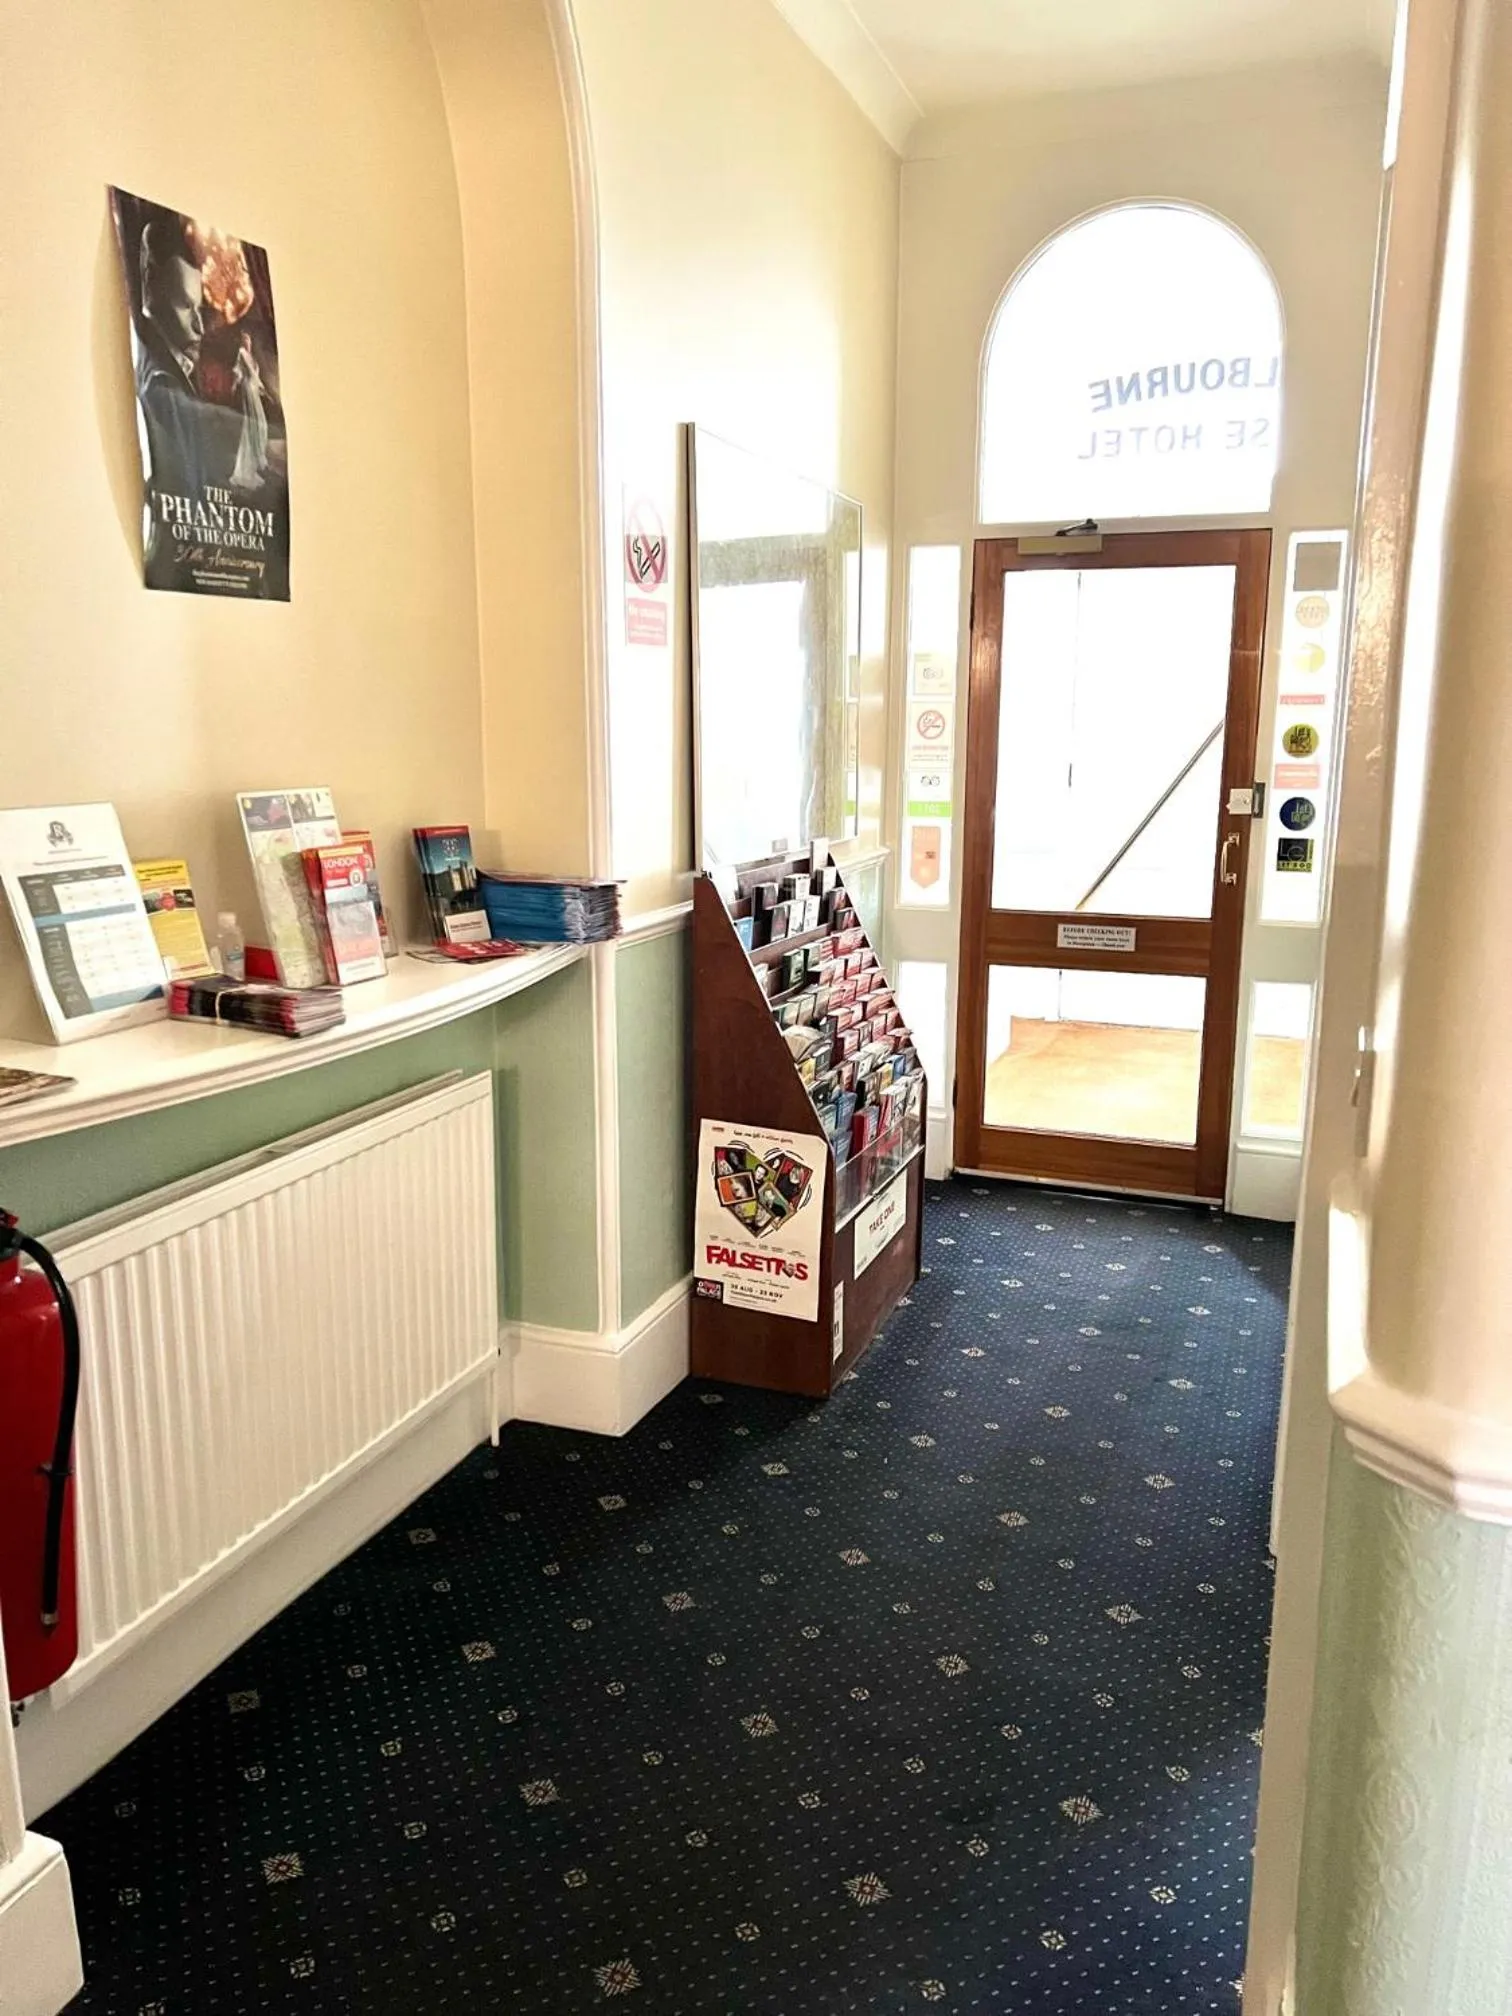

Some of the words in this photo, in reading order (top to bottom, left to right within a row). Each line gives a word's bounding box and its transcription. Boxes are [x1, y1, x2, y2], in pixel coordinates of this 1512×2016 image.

[203, 485, 232, 504] THE
[160, 492, 274, 538] PHANTOM
[171, 523, 191, 541] OF
[194, 527, 221, 545] THE
[223, 531, 265, 552] OPERA
[868, 1212, 885, 1233] TAKE
[884, 1200, 896, 1220] ONE
